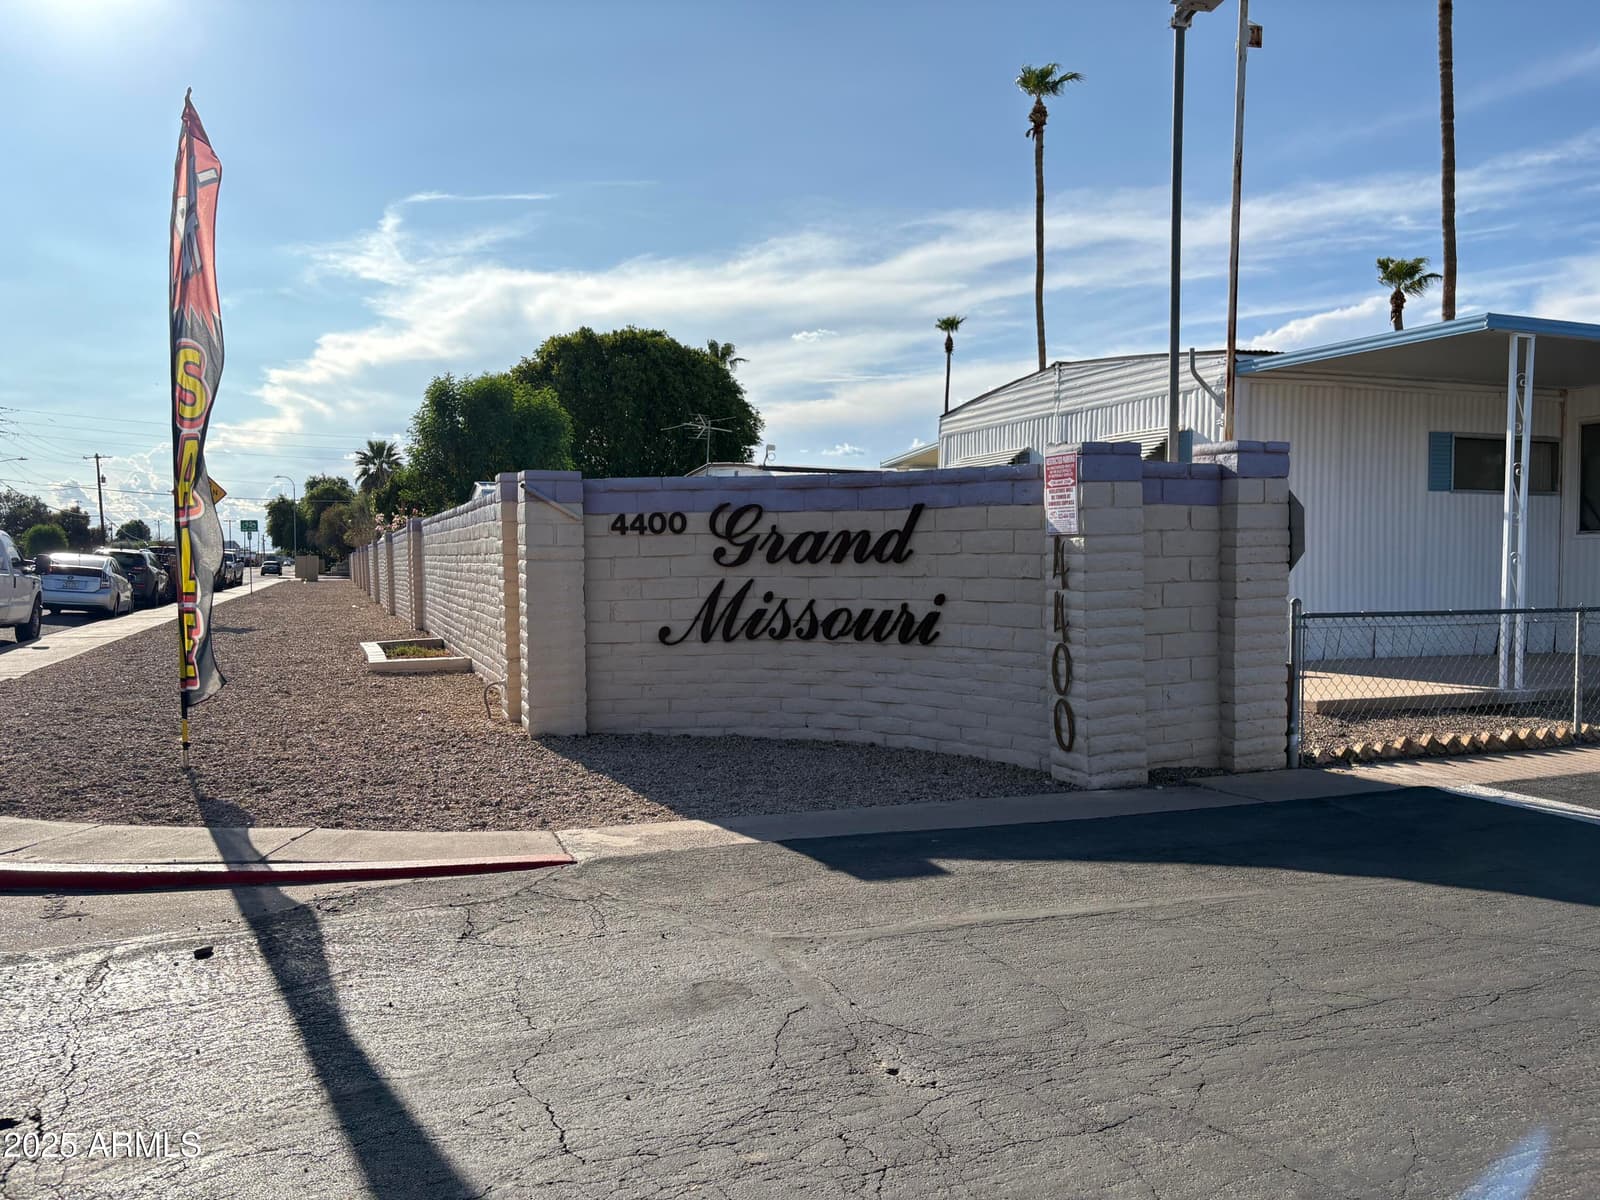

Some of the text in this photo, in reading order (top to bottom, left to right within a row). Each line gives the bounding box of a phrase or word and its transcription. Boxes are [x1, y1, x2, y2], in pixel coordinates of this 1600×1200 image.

[611, 511, 688, 536] 4400
[709, 502, 926, 568] Grand
[658, 578, 947, 646] Missouri
[1052, 534, 1075, 753] 4400
